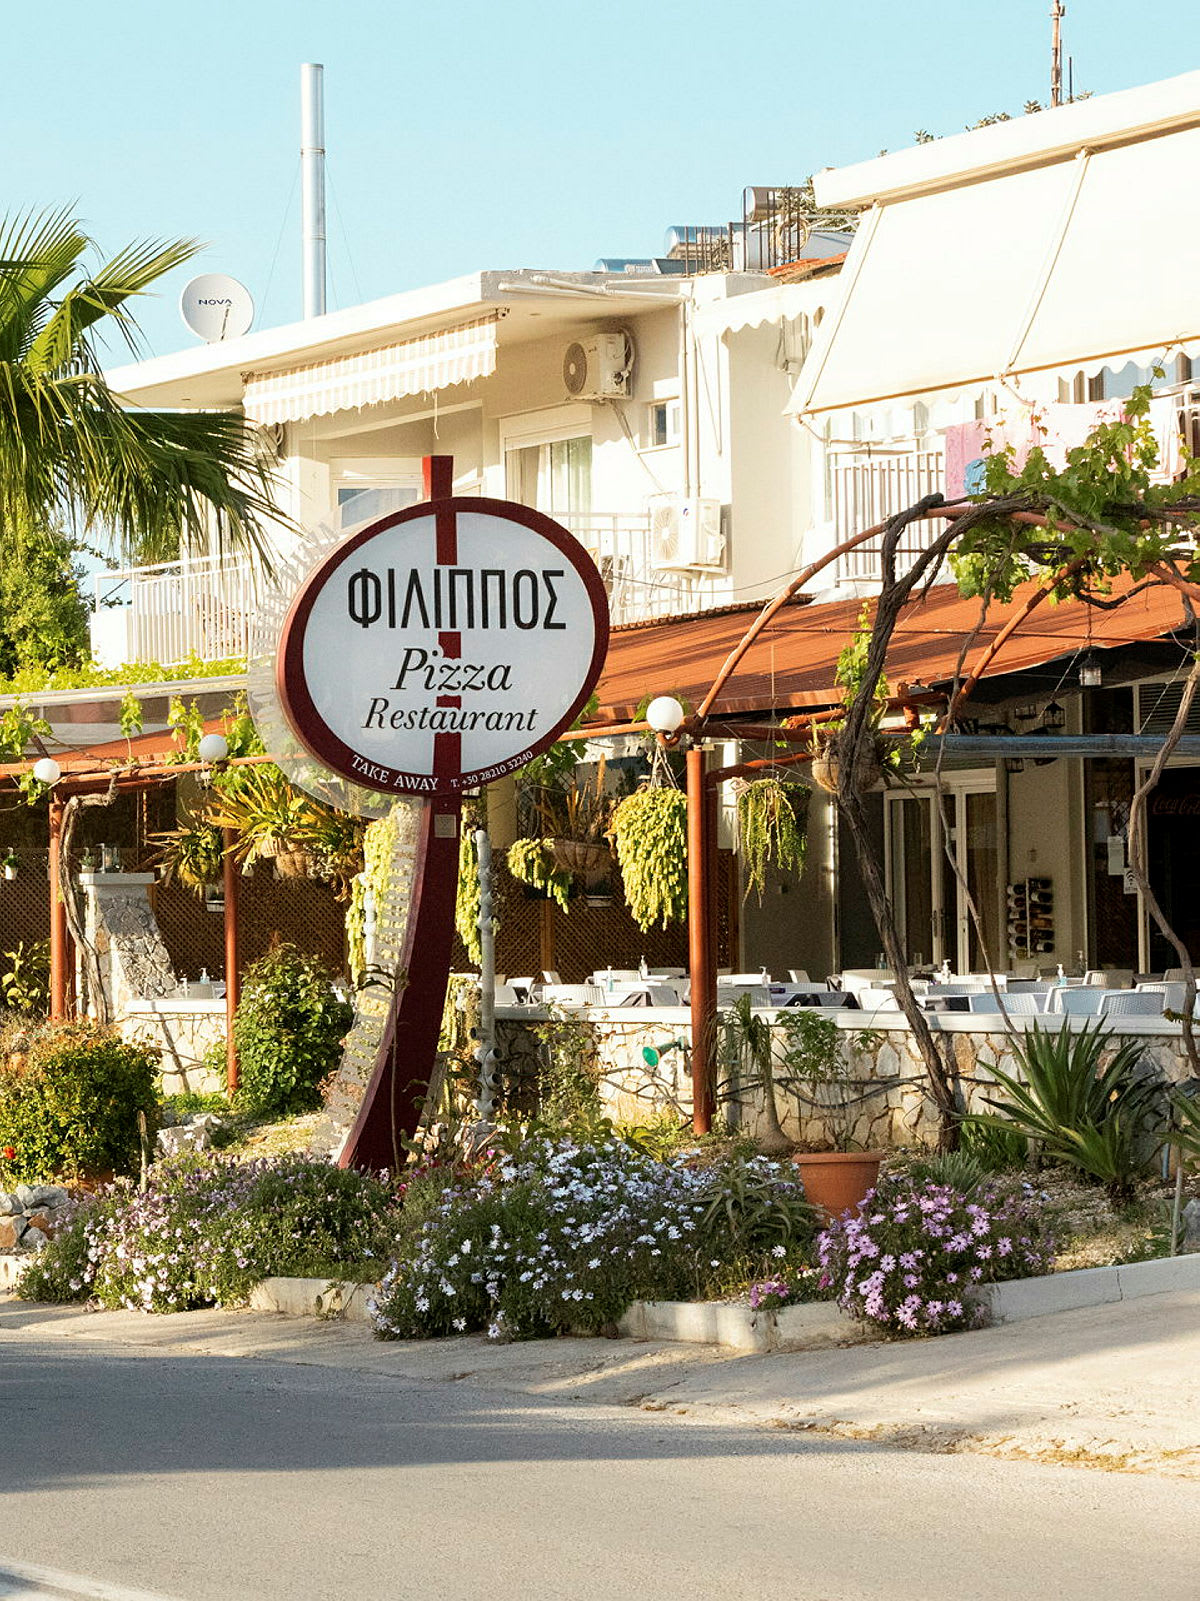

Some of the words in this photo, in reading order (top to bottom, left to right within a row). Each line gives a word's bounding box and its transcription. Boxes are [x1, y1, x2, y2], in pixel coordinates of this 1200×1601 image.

[348, 568, 567, 630] ΦΙΛΙΠΠΟΣ
[390, 647, 512, 691] Pizza
[361, 697, 539, 732] Restaurant
[351, 754, 390, 784] TAKE
[393, 774, 439, 791] AWAY
[480, 764, 507, 781] 28210
